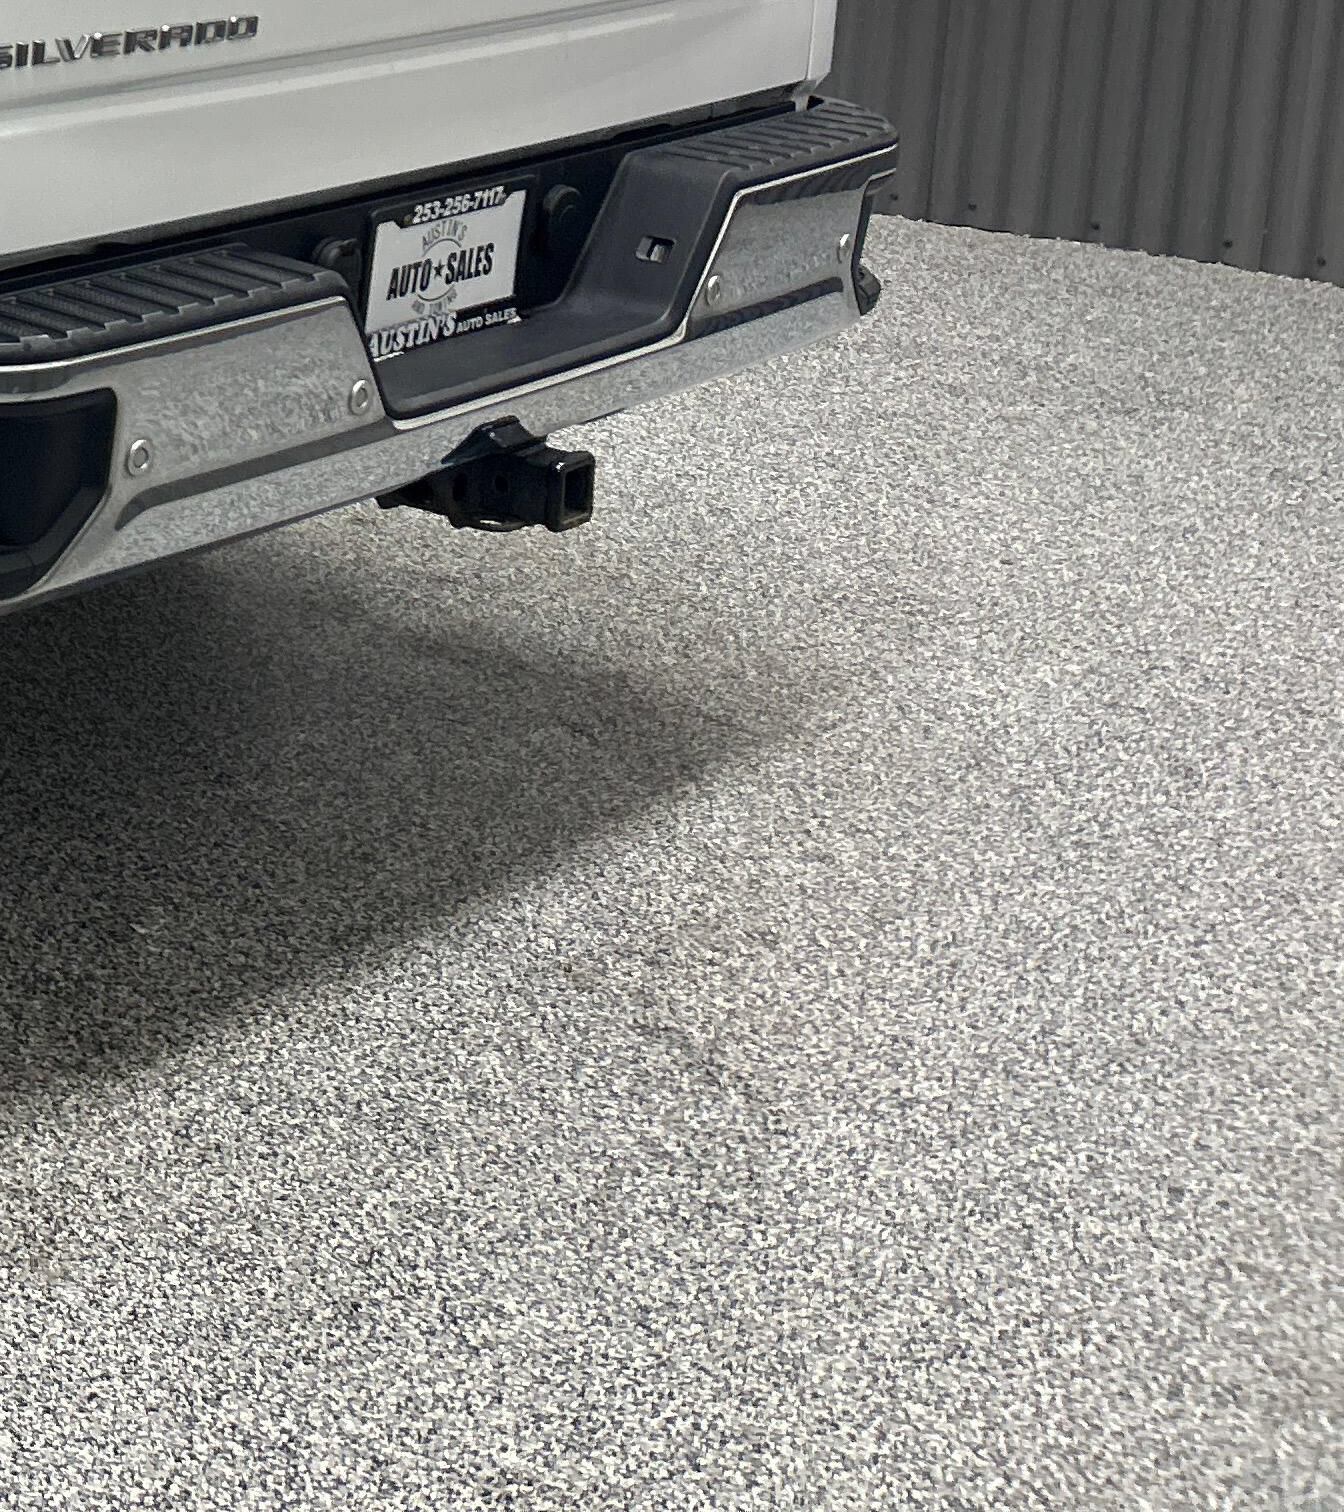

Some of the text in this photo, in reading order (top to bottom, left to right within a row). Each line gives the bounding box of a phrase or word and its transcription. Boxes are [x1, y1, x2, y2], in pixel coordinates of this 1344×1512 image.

[412, 187, 504, 224] 253-256-7117
[422, 220, 468, 247] AUSTIN'S
[387, 243, 495, 300] AUTO SALES
[369, 309, 517, 358] AUSTIN'S AUTO SALES
